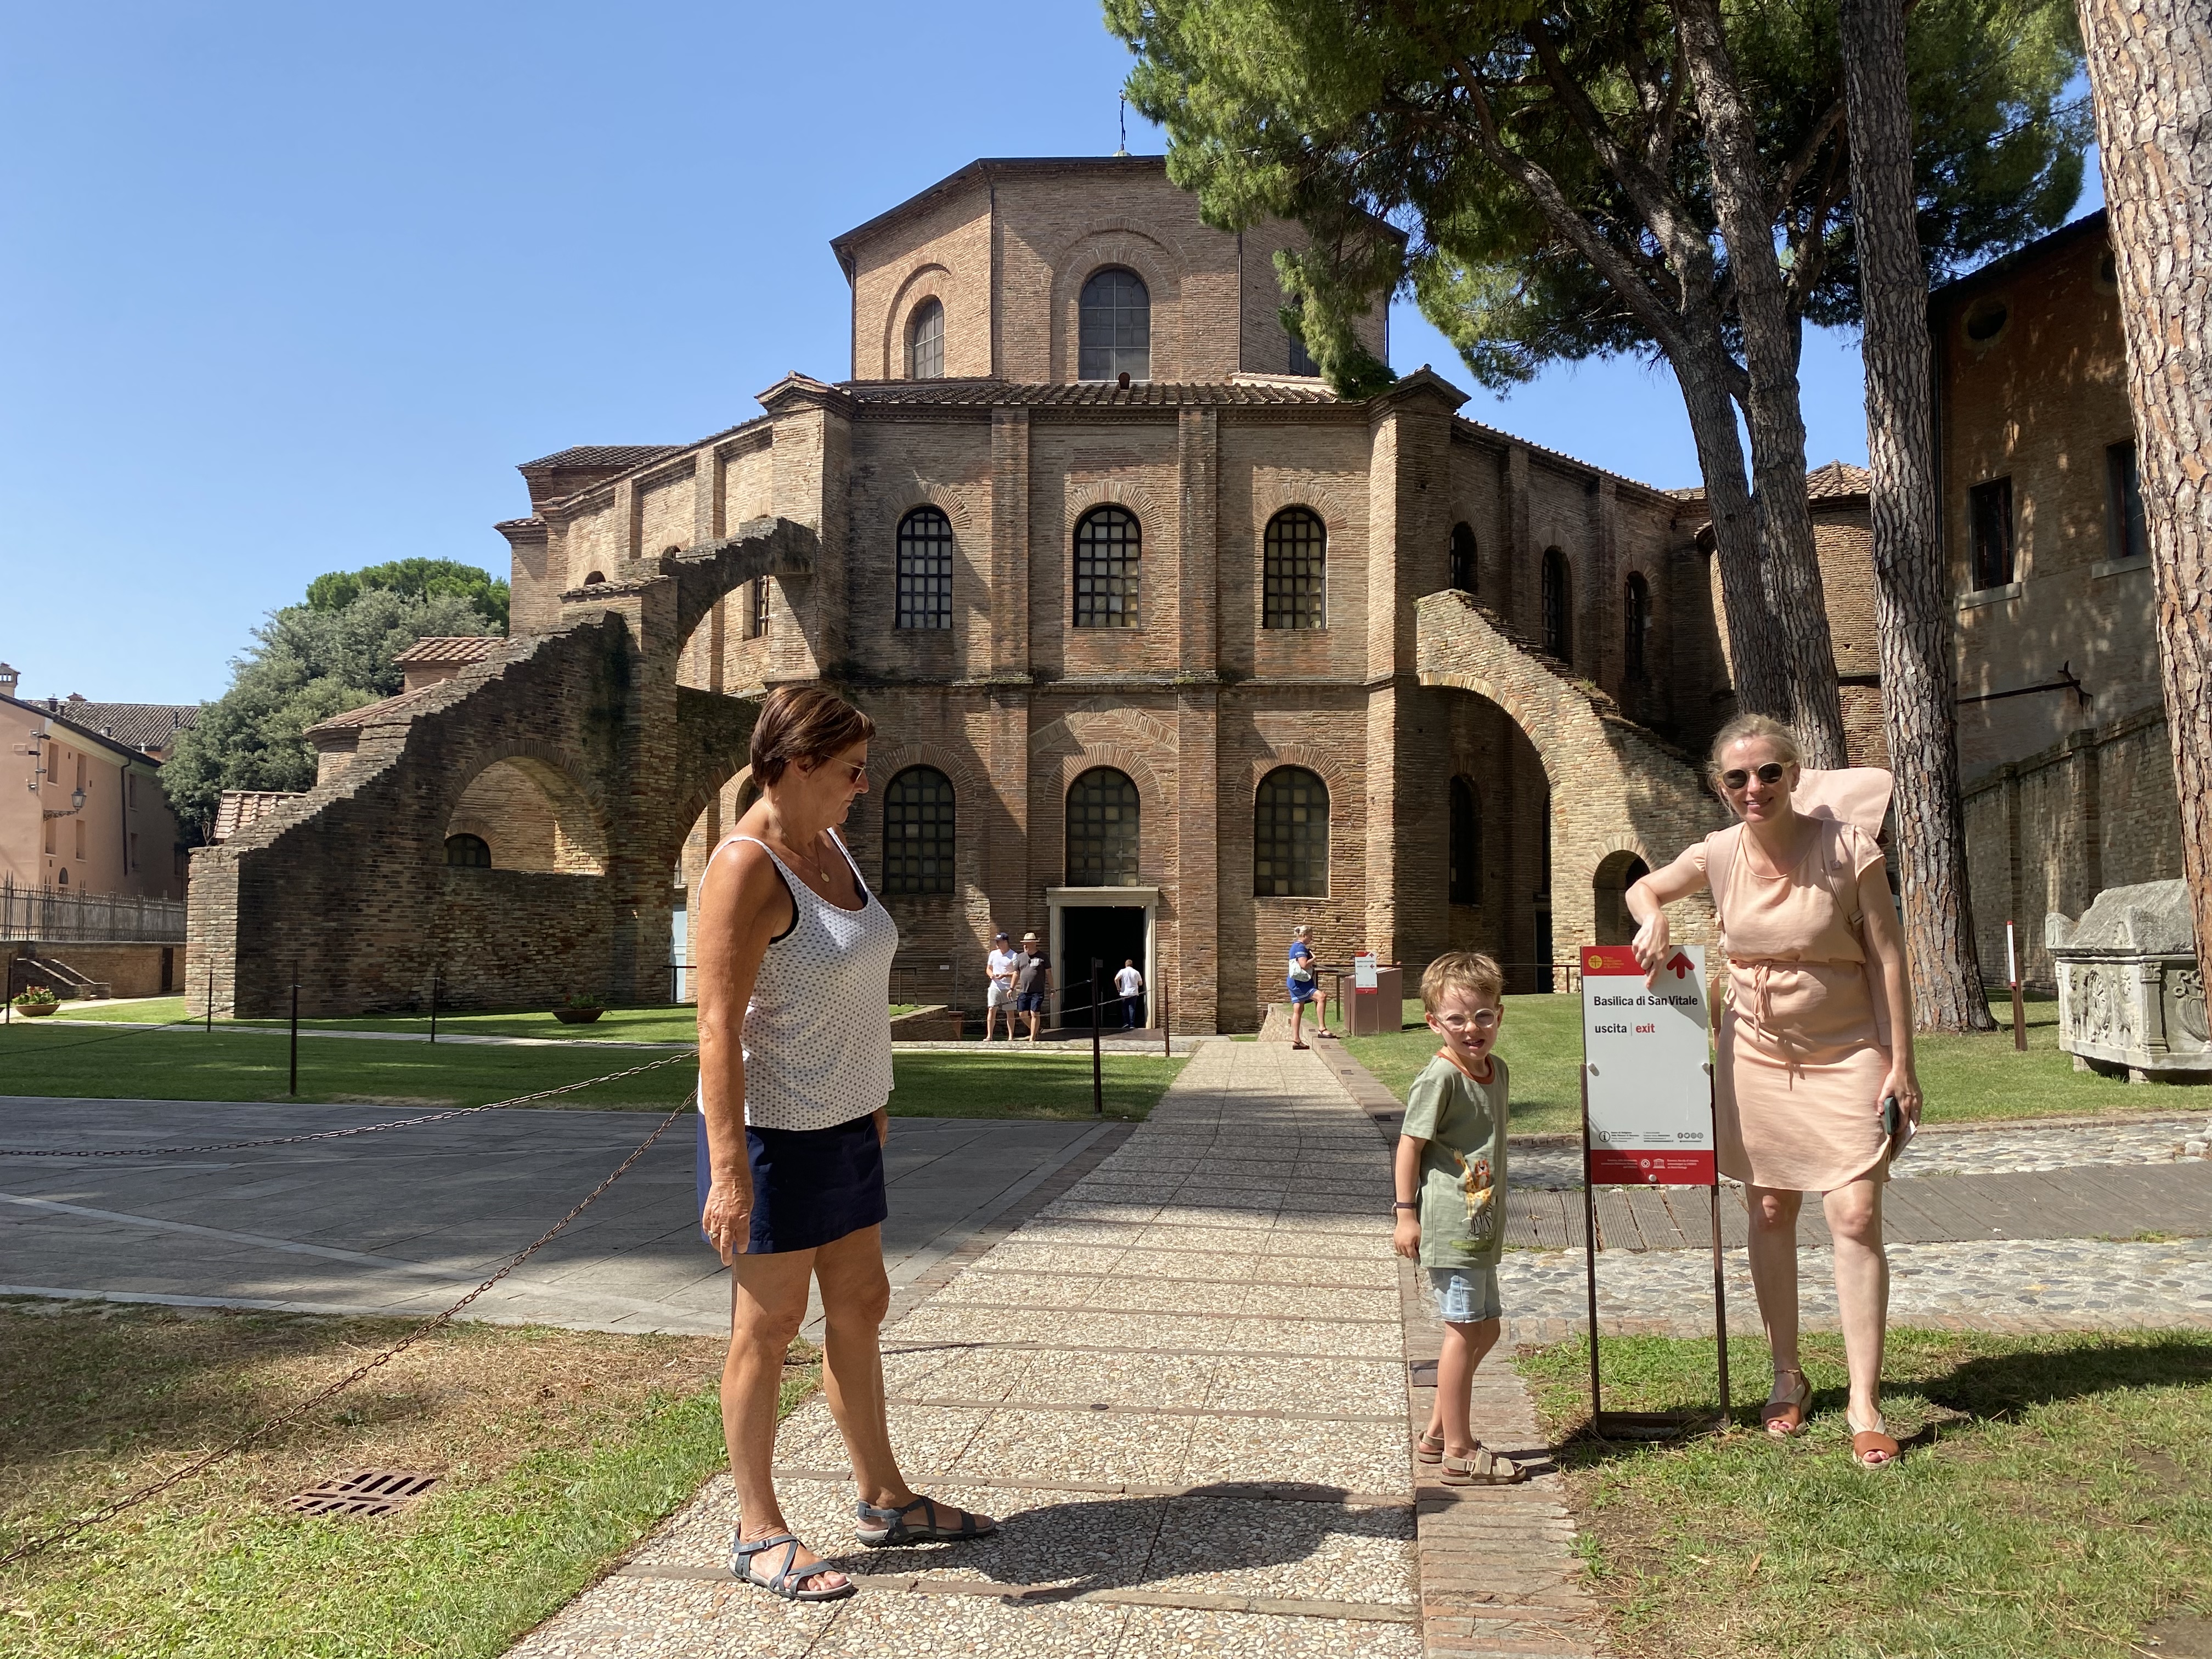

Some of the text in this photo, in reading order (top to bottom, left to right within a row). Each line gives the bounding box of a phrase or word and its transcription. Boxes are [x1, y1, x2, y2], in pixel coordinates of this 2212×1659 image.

[1594, 996, 1698, 1006] Basilica di San Vitale
[1595, 1023, 1655, 1033] uscita exit
